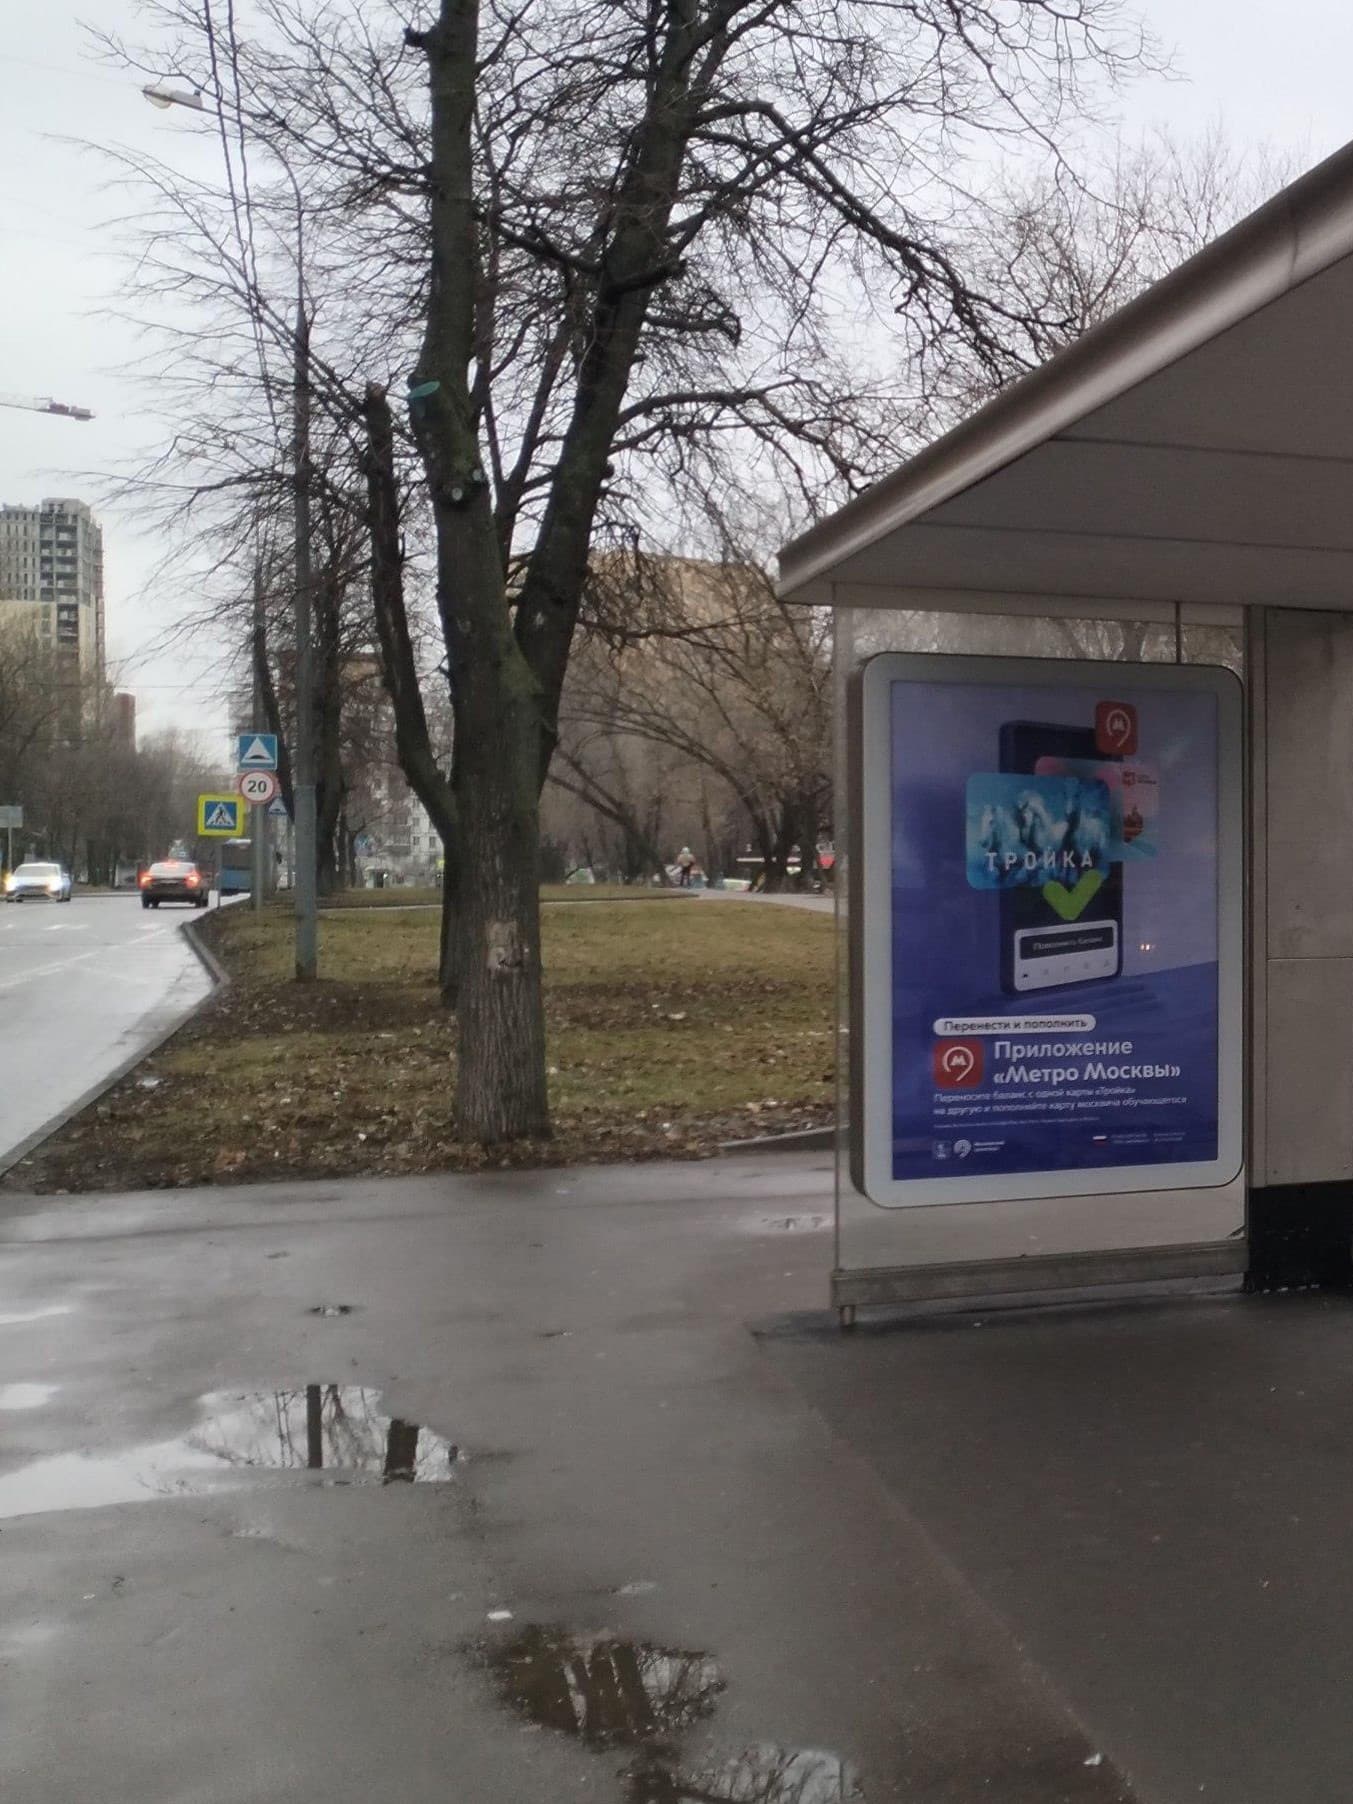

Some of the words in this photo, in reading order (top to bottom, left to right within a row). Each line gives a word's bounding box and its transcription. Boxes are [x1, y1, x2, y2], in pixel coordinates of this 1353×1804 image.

[247, 780, 267, 793] 20
[983, 846, 1094, 873] ТРОЙКА
[944, 1020, 1011, 1033] Перенести
[1013, 1020, 1022, 1029] и
[1024, 1018, 1088, 1030] пополнить
[994, 1040, 1134, 1062] Приложение
[993, 1065, 1079, 1085] «Метро
[1083, 1063, 1181, 1081] Москвы»
